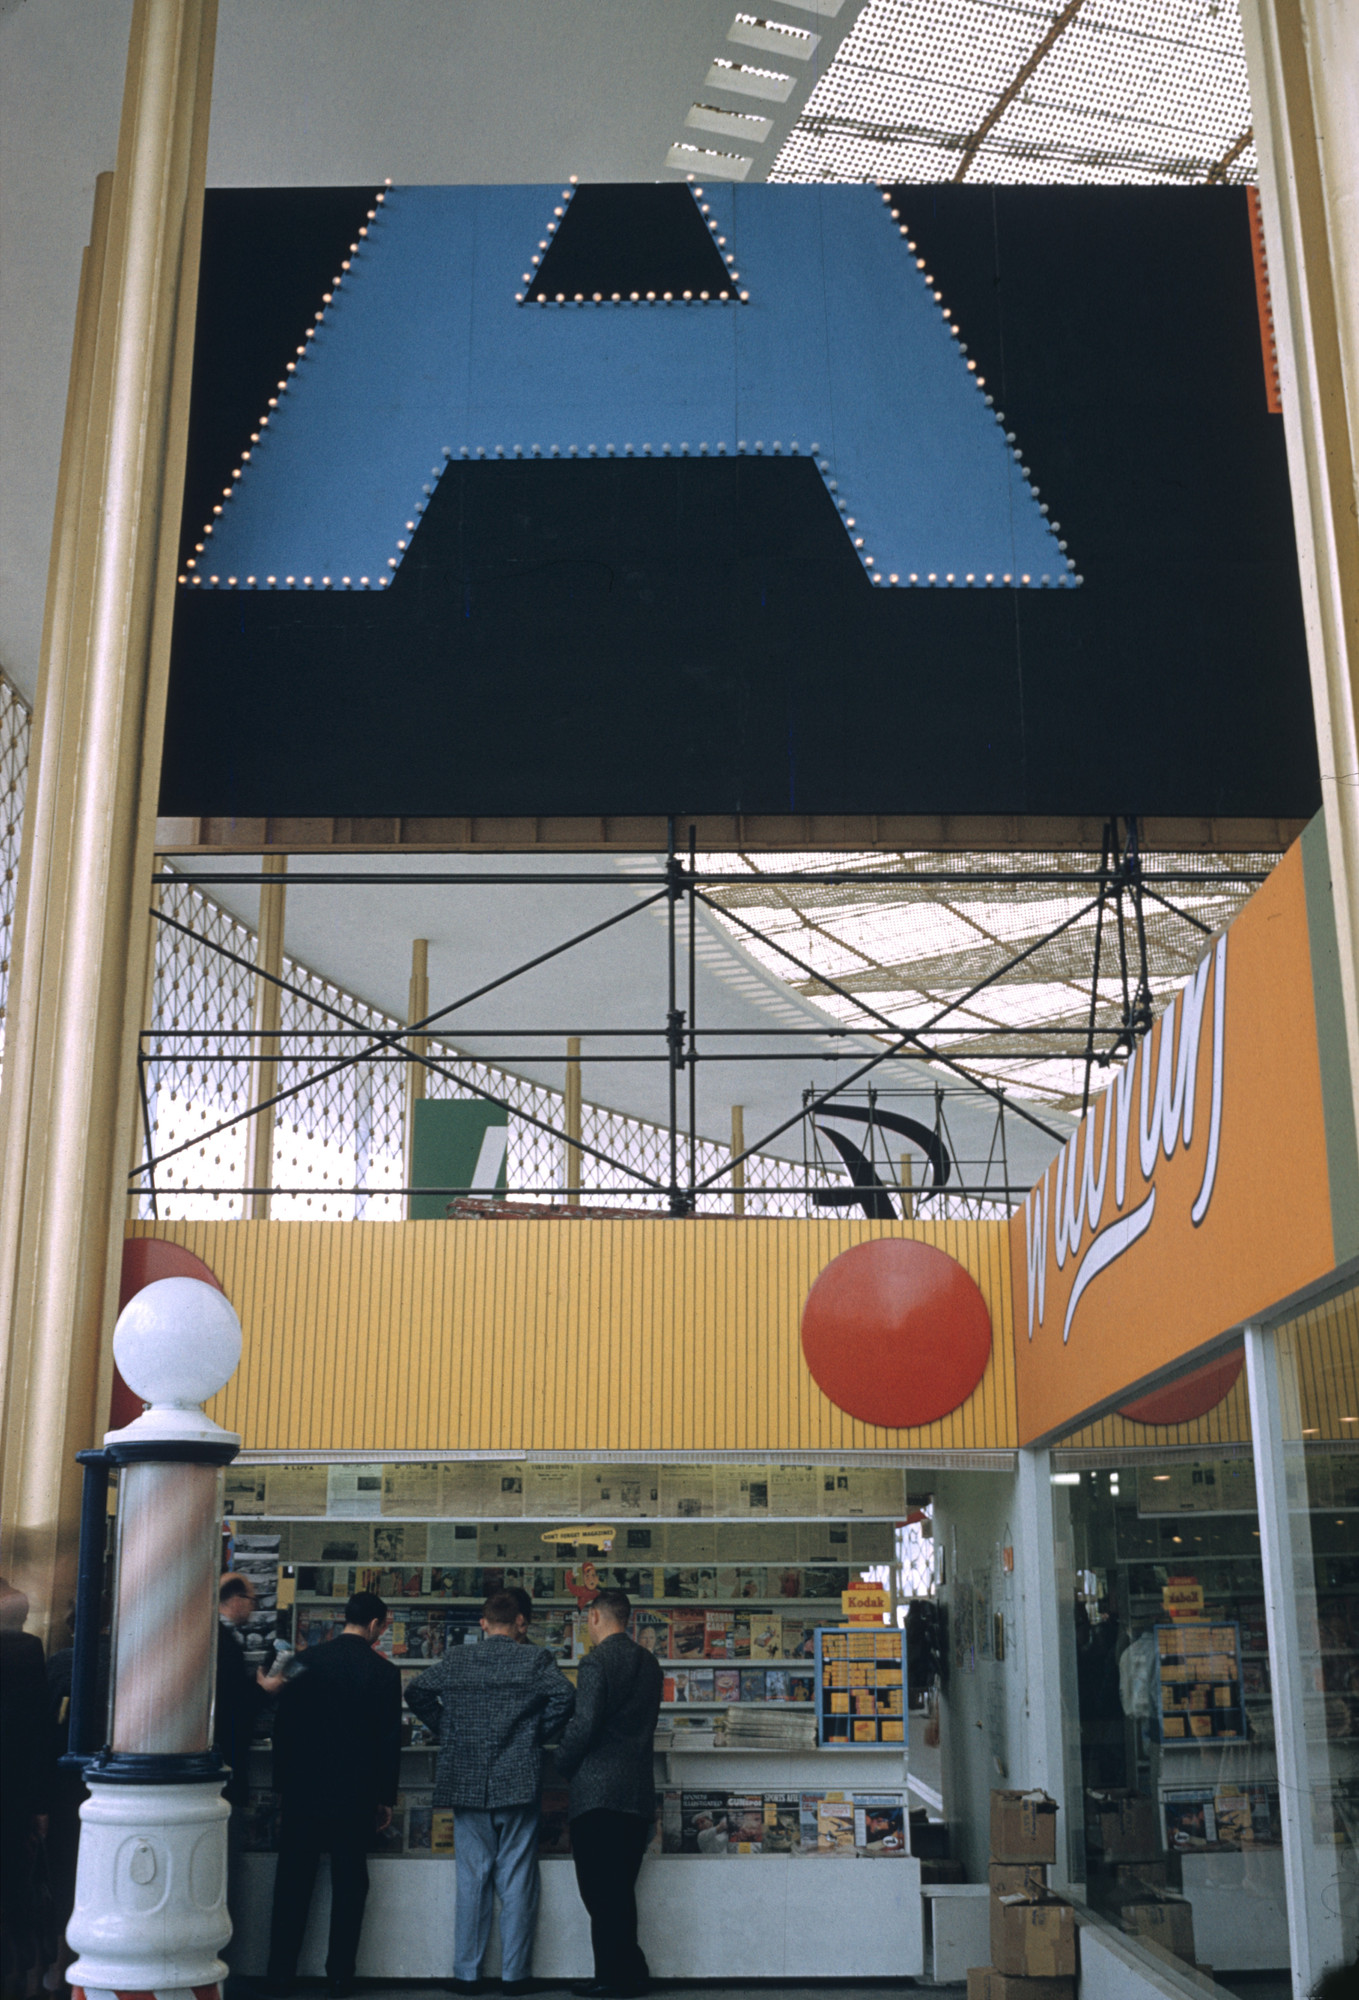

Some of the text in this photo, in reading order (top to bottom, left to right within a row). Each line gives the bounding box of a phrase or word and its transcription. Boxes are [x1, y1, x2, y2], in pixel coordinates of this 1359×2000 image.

[582, 1529, 614, 1537] MAGAZINES
[847, 1596, 885, 1608] Kodak
[763, 1793, 786, 1803] SPORTS
